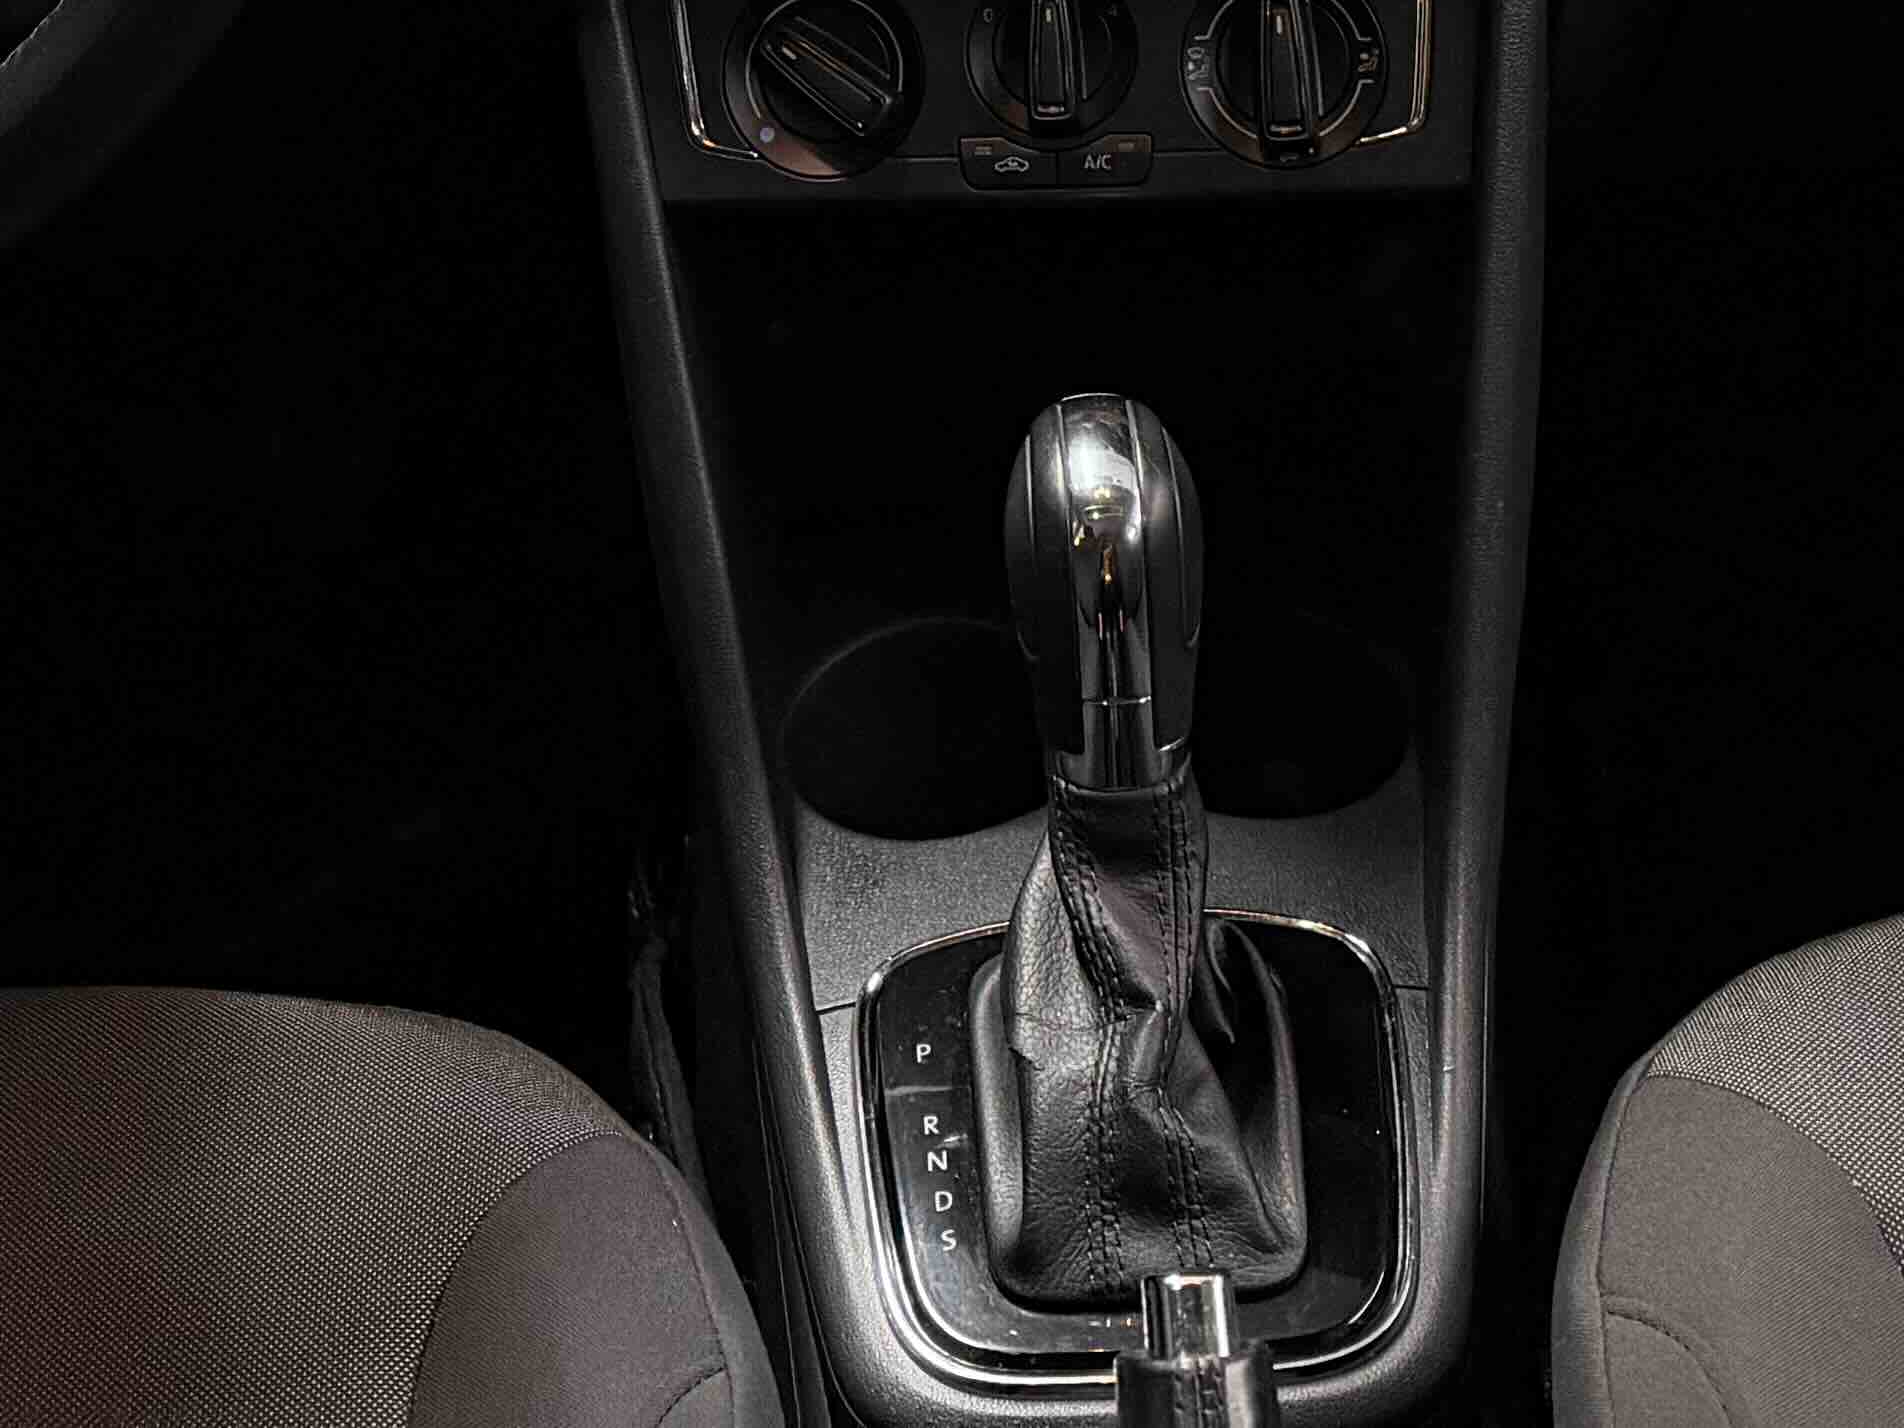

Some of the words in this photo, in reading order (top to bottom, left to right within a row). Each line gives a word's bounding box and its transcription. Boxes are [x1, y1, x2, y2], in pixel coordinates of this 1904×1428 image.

[1084, 153, 1112, 172] A/C
[915, 1042, 932, 1065] P
[923, 1115, 939, 1137] R
[927, 1150, 948, 1172] N
[935, 1190, 954, 1213] D
[941, 1228, 957, 1252] S
